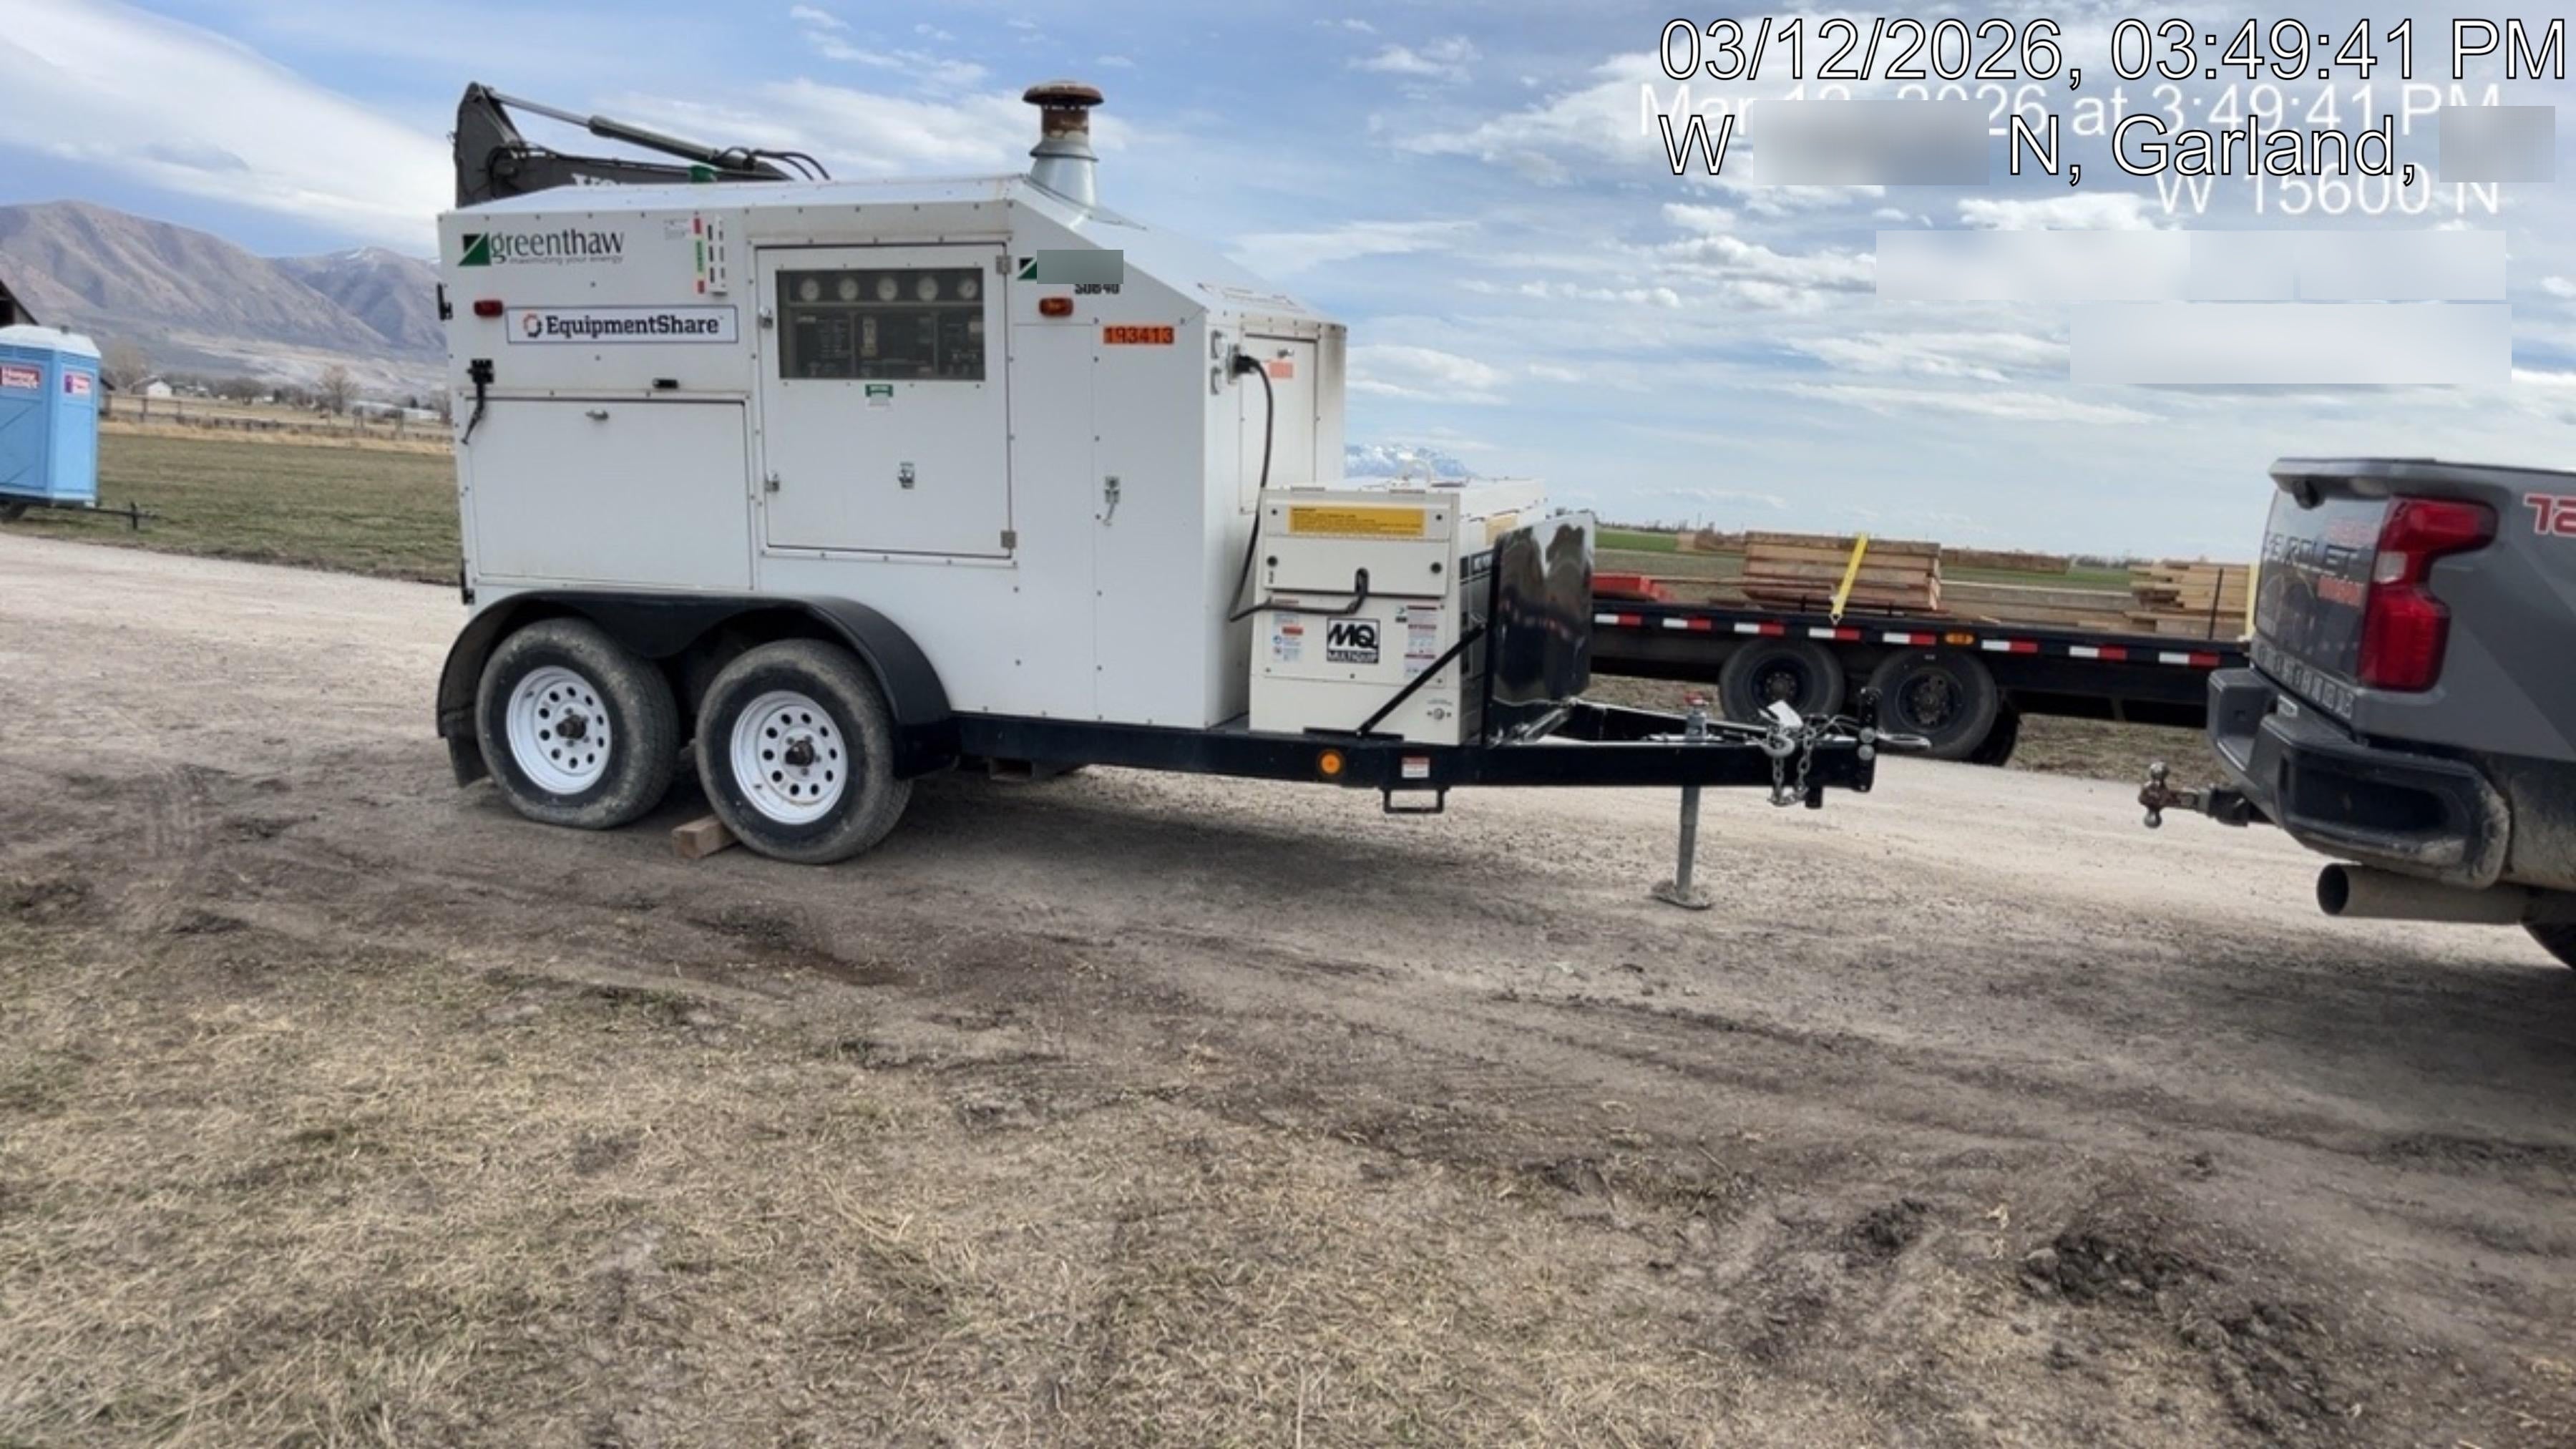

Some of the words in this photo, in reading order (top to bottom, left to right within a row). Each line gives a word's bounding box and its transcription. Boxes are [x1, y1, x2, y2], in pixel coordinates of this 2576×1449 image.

[492, 228, 624, 263] greenthaw
[545, 314, 720, 339] EquipmentShare
[1105, 326, 1174, 344] 193413
[1327, 623, 1378, 649] MQ
